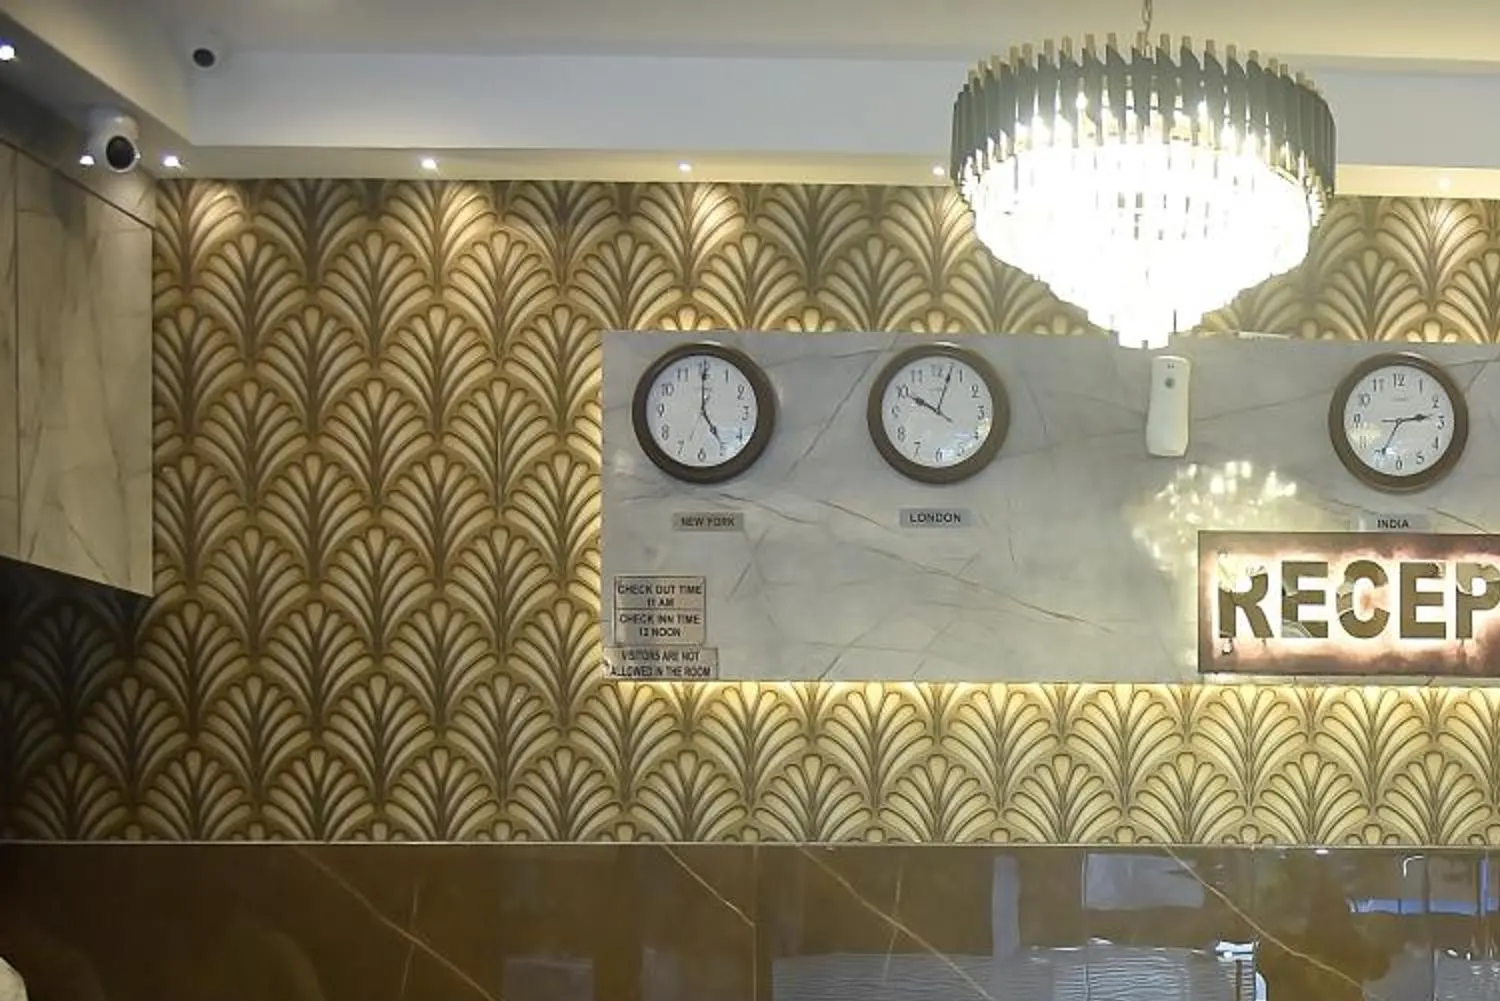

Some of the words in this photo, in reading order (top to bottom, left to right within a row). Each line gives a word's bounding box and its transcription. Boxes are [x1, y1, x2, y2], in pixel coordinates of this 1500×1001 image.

[677, 367, 689, 382] 11
[911, 369, 922, 383] 11
[1393, 373, 1405, 388] 12
[661, 383, 674, 397] 10
[737, 384, 745, 400] 2
[970, 384, 979, 399] 2
[657, 403, 665, 417] 9
[742, 405, 750, 421] 3
[977, 405, 985, 421] 3
[1437, 415, 1445, 430] 3
[661, 424, 669, 440] 8
[697, 448, 706, 462] 6
[1416, 451, 1424, 465] 5
[909, 512, 961, 524] LONDON
[1377, 519, 1409, 529] INDIA
[617, 585, 653, 595] CHECK
[655, 584, 676, 594] OUT
[679, 584, 702, 595] TIME
[619, 614, 654, 624] CHECK
[678, 614, 701, 625] TIME
[651, 627, 681, 637] NOON
